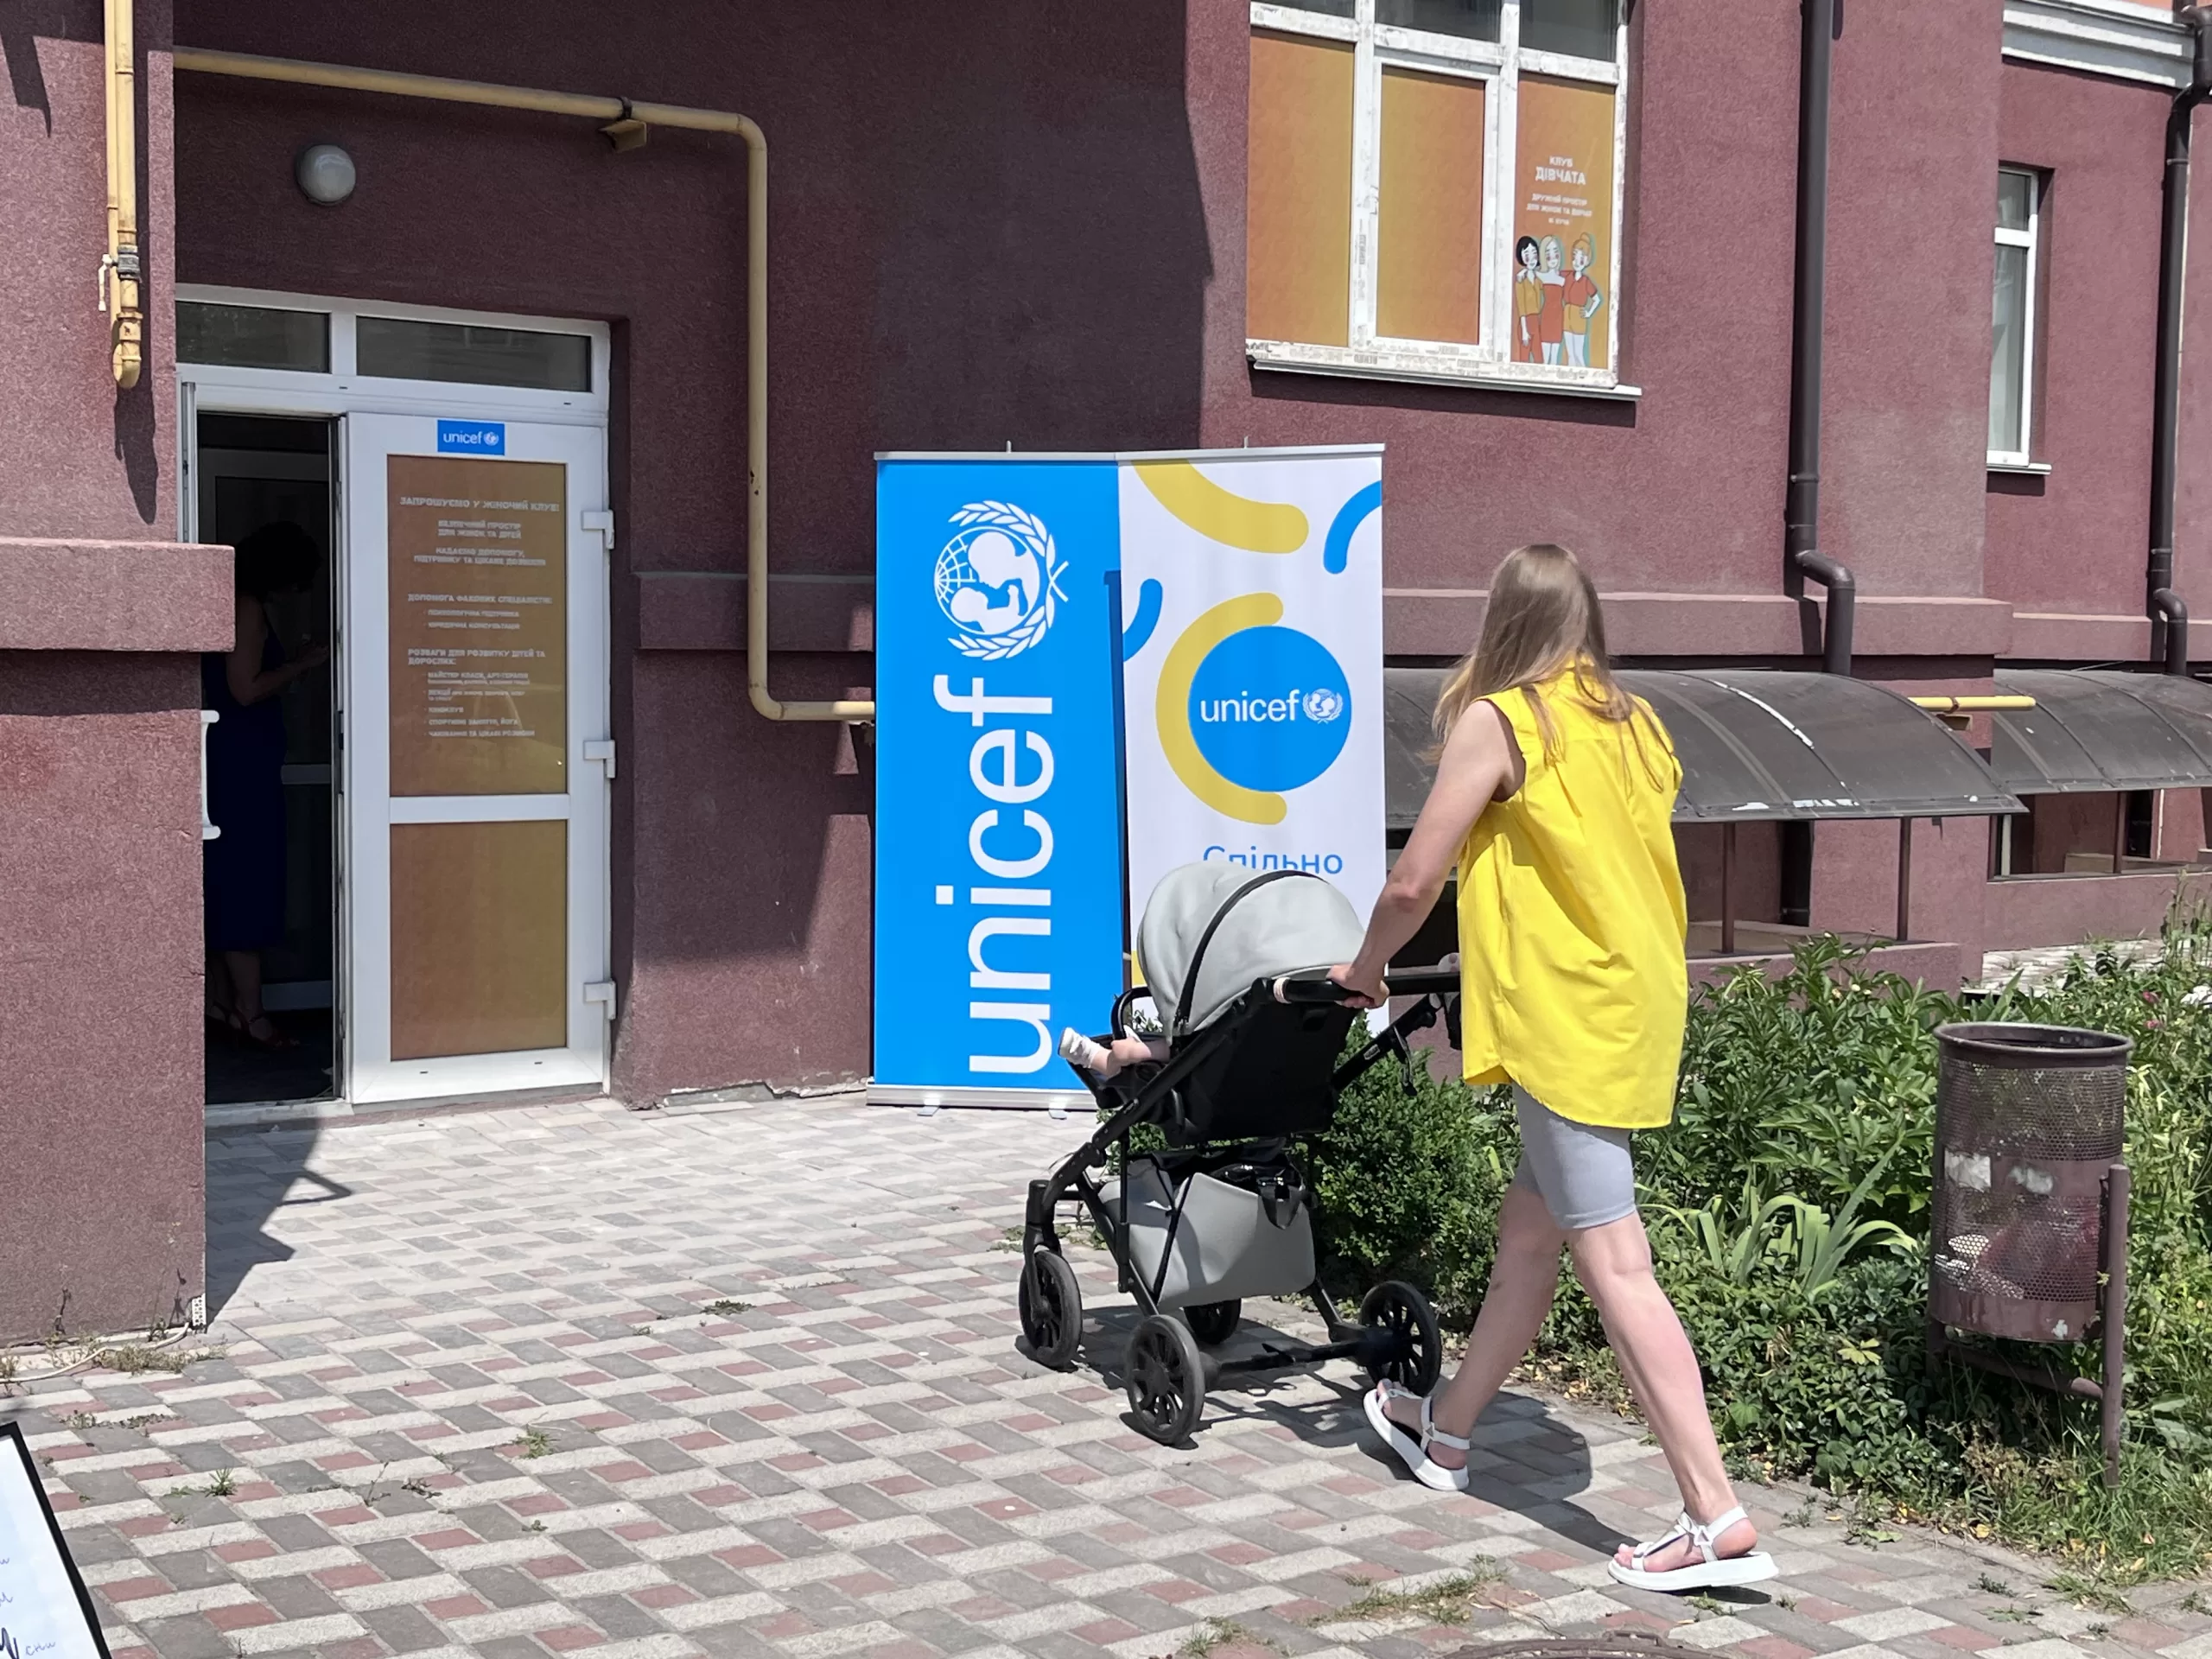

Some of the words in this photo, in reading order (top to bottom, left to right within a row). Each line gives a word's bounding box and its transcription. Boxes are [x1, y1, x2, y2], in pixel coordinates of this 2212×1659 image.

[1535, 166, 1586, 185] ДІВЧАТА
[442, 430, 483, 444] unicef
[400, 497, 470, 508] ЗАПРОШУЄМО
[482, 499, 528, 511] ЖІНОЧИЙ
[408, 594, 454, 602] ДОПОМОГА
[408, 648, 446, 657] РОЗВАГИ
[1200, 689, 1300, 722] unicef
[932, 674, 1055, 1074] unicef
